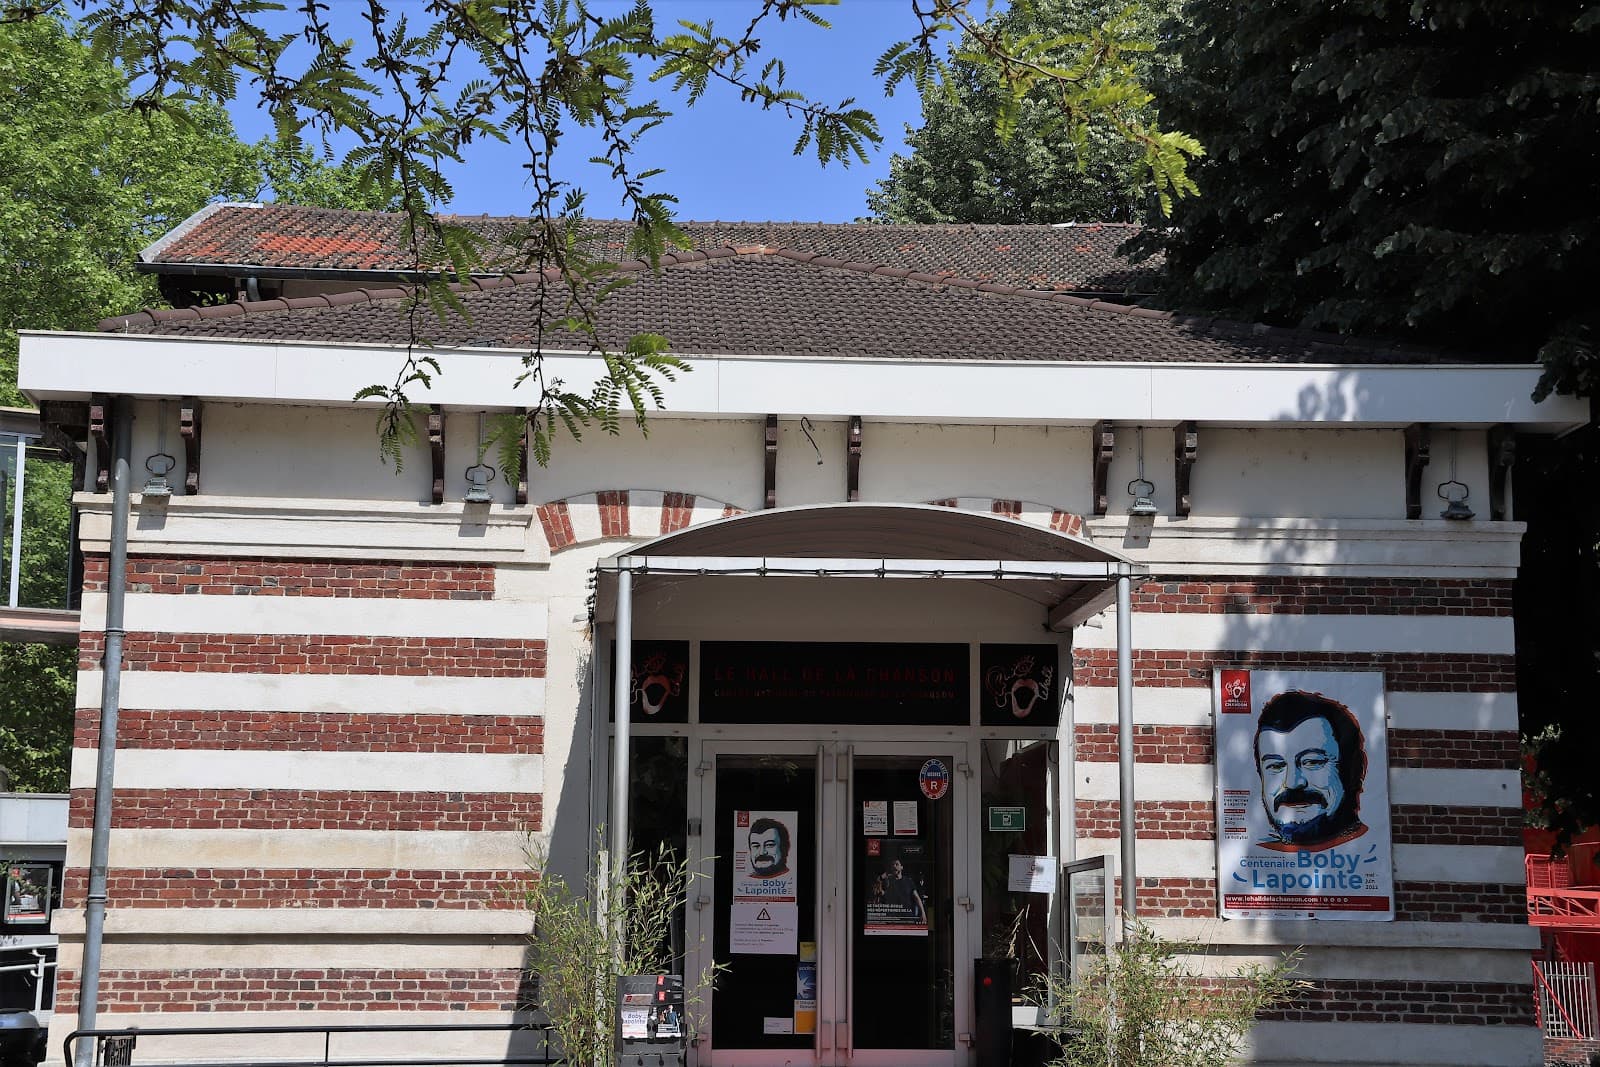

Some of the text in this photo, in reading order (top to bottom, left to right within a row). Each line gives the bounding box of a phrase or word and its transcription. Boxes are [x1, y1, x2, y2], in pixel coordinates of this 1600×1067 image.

[714, 665, 955, 684] LE HALL DE LA CHANSON
[931, 781, 938, 790] R
[1240, 849, 1361, 873] Centenaire Boby
[762, 879, 787, 888] Boby
[1253, 869, 1363, 893] Lapointe
[745, 887, 788, 896] Lapointe
